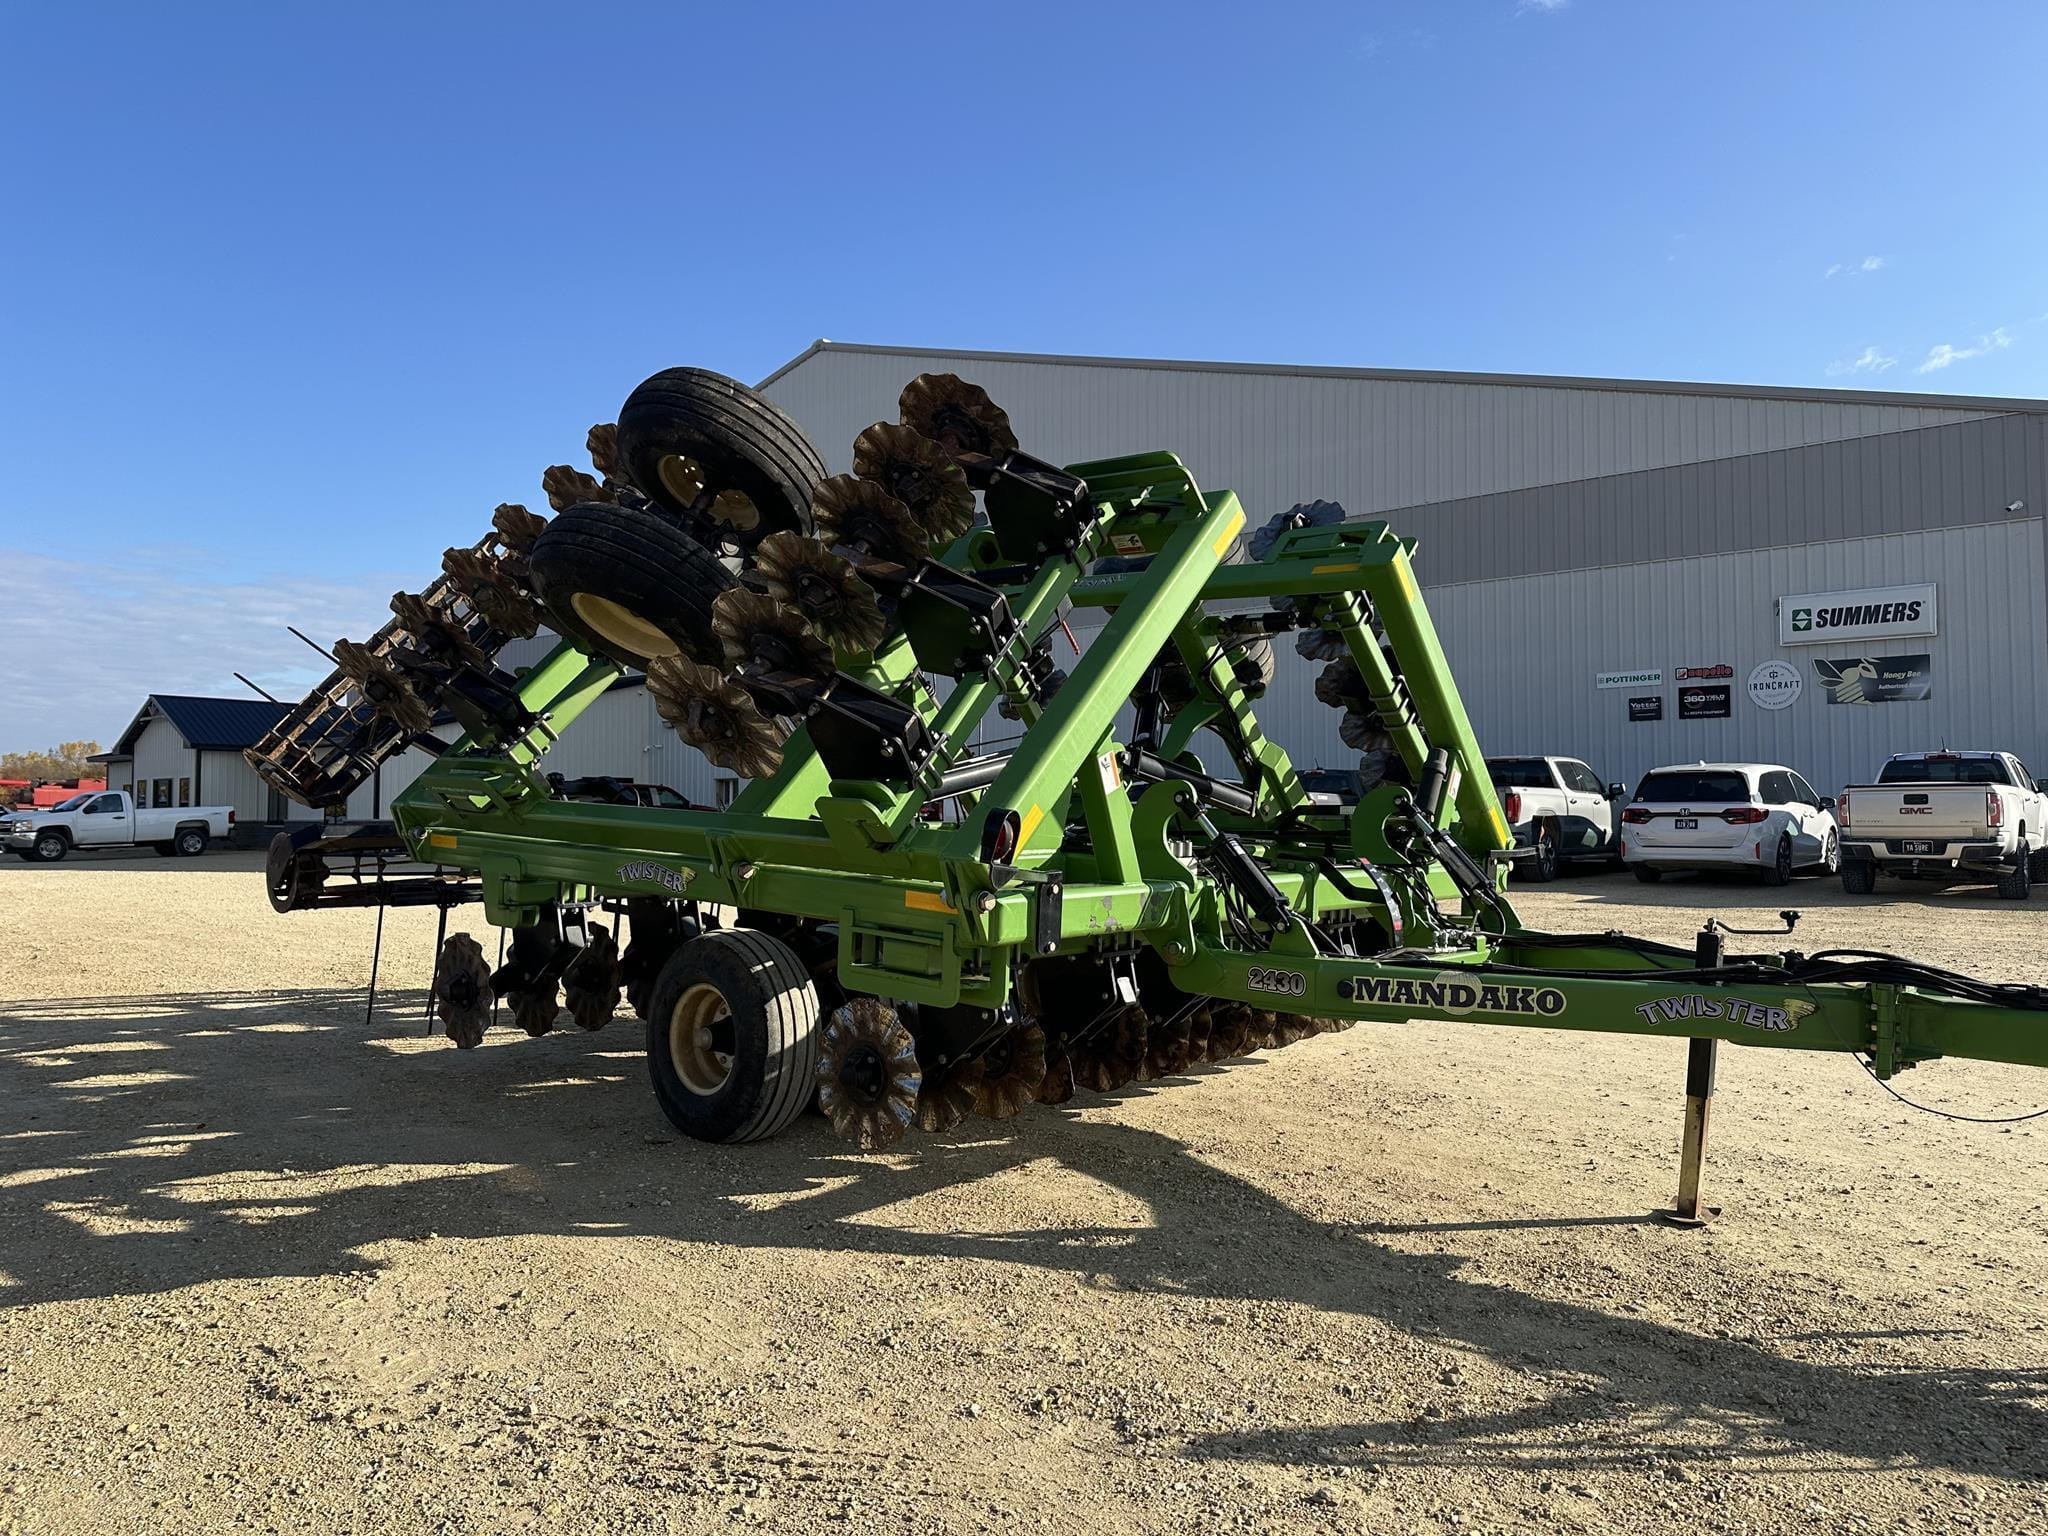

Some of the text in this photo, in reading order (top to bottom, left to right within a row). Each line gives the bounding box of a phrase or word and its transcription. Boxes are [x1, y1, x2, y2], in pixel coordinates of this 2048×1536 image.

[1815, 601, 1922, 628] SUMMERS
[1683, 695, 1705, 703] 360
[1749, 680, 1800, 691] IRONCRAFT
[1899, 807, 1933, 815] GMC
[616, 861, 684, 893] TWISTER
[1248, 967, 1306, 996] 2430
[1354, 977, 1565, 1014] MANDAKO
[1635, 995, 1791, 1031] TWISTER
